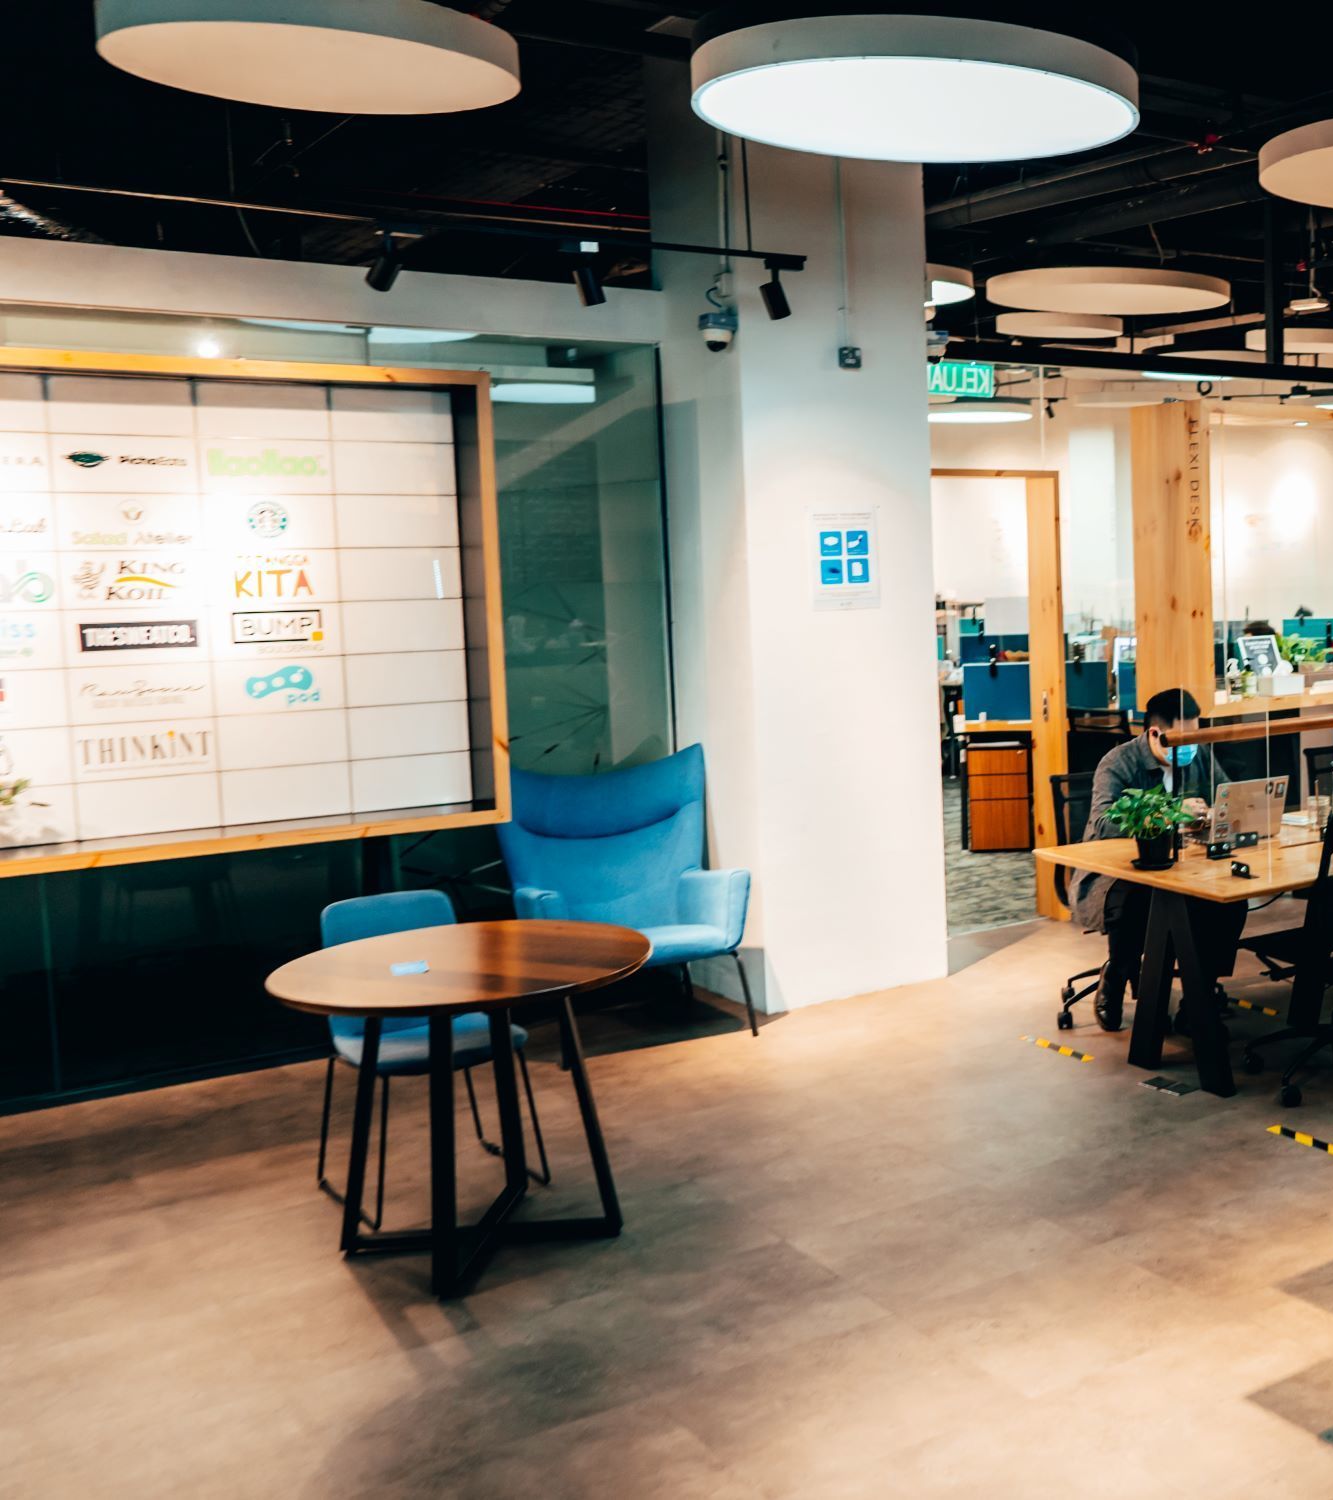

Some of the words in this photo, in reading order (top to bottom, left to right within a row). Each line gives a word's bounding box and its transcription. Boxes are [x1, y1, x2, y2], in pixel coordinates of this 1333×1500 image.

[1190, 480, 1202, 528] DESK
[117, 560, 186, 575] KING
[234, 568, 315, 599] KITA
[288, 689, 320, 707] pod
